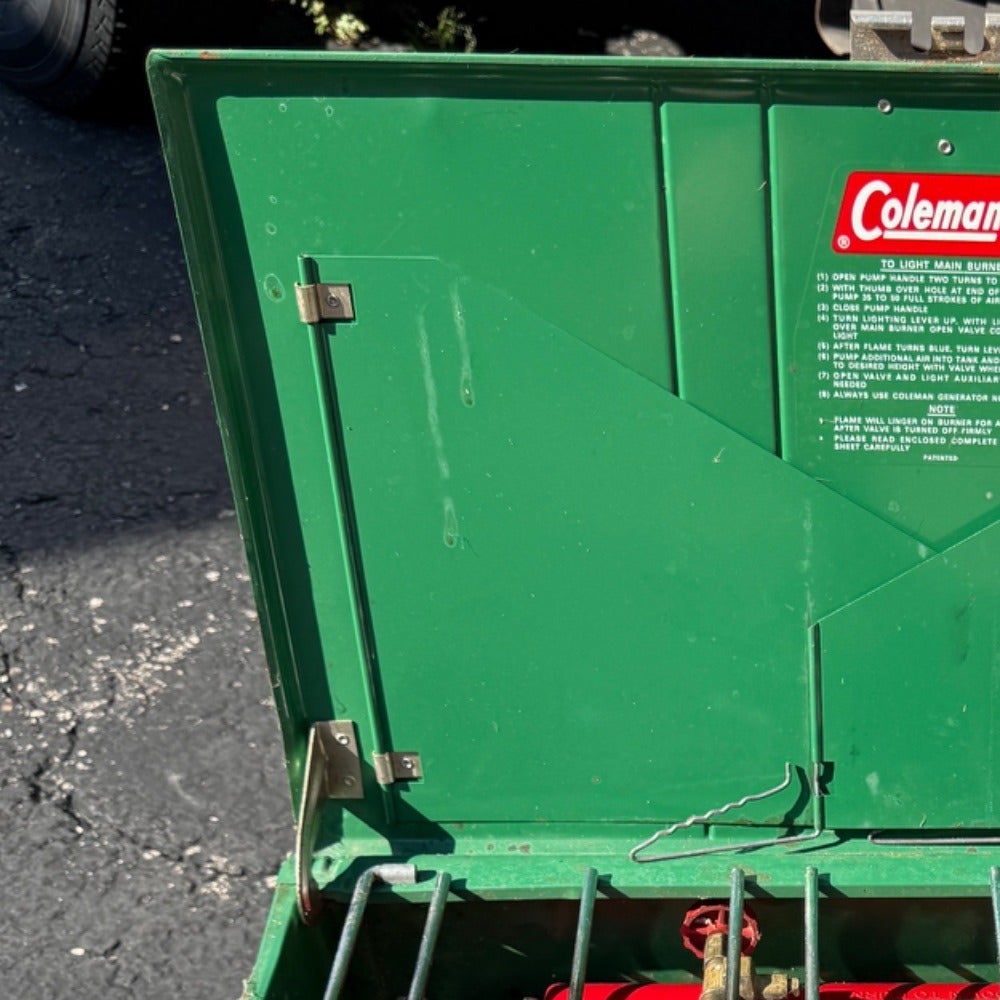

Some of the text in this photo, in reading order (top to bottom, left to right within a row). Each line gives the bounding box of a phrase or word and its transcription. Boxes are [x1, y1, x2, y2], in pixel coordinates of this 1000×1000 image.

[881, 259, 895, 269] TO
[899, 260, 930, 270] LIGHT
[934, 260, 962, 270] MAIN
[816, 272, 829, 282] (1)
[832, 273, 856, 282] OPEN
[860, 273, 886, 282] PUMP
[889, 274, 925, 283] HANDLE
[928, 275, 949, 284] TWO
[952, 276, 982, 285] TURNS
[986, 276, 998, 285] TO
[817, 283, 829, 292] (2)
[832, 283, 855, 292] WITH
[859, 284, 892, 293] THUMB
[896, 285, 919, 294] OVER
[924, 286, 947, 295] HOLE
[950, 286, 962, 295] AT
[966, 287, 984, 296] END
[988, 287, 1000, 296] OF
[832, 292, 859, 301] PUMP
[875, 293, 887, 302] TO
[904, 294, 924, 303] FULL
[927, 294, 967, 304] STROKES
[970, 296, 982, 304] OF
[985, 296, 1000, 304] AIR
[832, 303, 860, 312] CLOSE
[864, 304, 890, 313] PUMP
[893, 305, 928, 314] HANDLE
[817, 313, 829, 322] (4)
[832, 314, 858, 322] TURN
[862, 315, 906, 324] LIGHTING
[910, 316, 940, 324] LEVER
[963, 317, 987, 325] WITH
[832, 322, 856, 332] OVER
[860, 323, 884, 332] MAIN
[888, 324, 924, 333] BURNER
[929, 325, 953, 334] OPEN
[958, 326, 985, 335] VALVE
[833, 331, 858, 340] LIGHT
[833, 341, 860, 351] AFTER
[864, 343, 892, 351] FLAME
[896, 343, 925, 352] TURNS
[956, 345, 980, 354] TURN
[833, 352, 859, 361] PUMP
[861, 353, 914, 363] ADDITIONAL
[916, 355, 930, 363] AIR
[932, 355, 953, 364] INTO
[955, 355, 978, 364] TANK
[980, 356, 1000, 364] AND
[833, 361, 845, 369] TO
[848, 361, 885, 370] DESIRED
[888, 362, 920, 371] HEIGHT
[922, 363, 945, 372] WITH
[948, 363, 976, 373] VALVE
[818, 371, 830, 380] (7)
[833, 372, 859, 380] OPEN
[863, 372, 892, 381] VALVE
[896, 373, 916, 382] AND
[921, 374, 949, 383] LIGHT
[833, 380, 867, 389] NEEDED
[833, 388, 869, 399] ALWAYS
[872, 392, 888, 400] USE
[892, 392, 934, 401] COLEMAN
[937, 393, 988, 402] GENERATOR
[928, 404, 955, 413] NOTE
[834, 416, 862, 424] FLAME
[888, 417, 918, 426] LINGER
[921, 418, 933, 426] ON
[938, 418, 972, 427] BURNER
[975, 419, 992, 428] FOR
[834, 424, 992, 435] AFTER VALVE IS TURNED OFF FIRMLY
[834, 434, 866, 442] PLEASE
[871, 435, 895, 443] READ
[900, 436, 946, 444] ENCLOSED
[950, 436, 997, 446] COMPLETE
[834, 442, 910, 452] SHEET CAREFULLY
